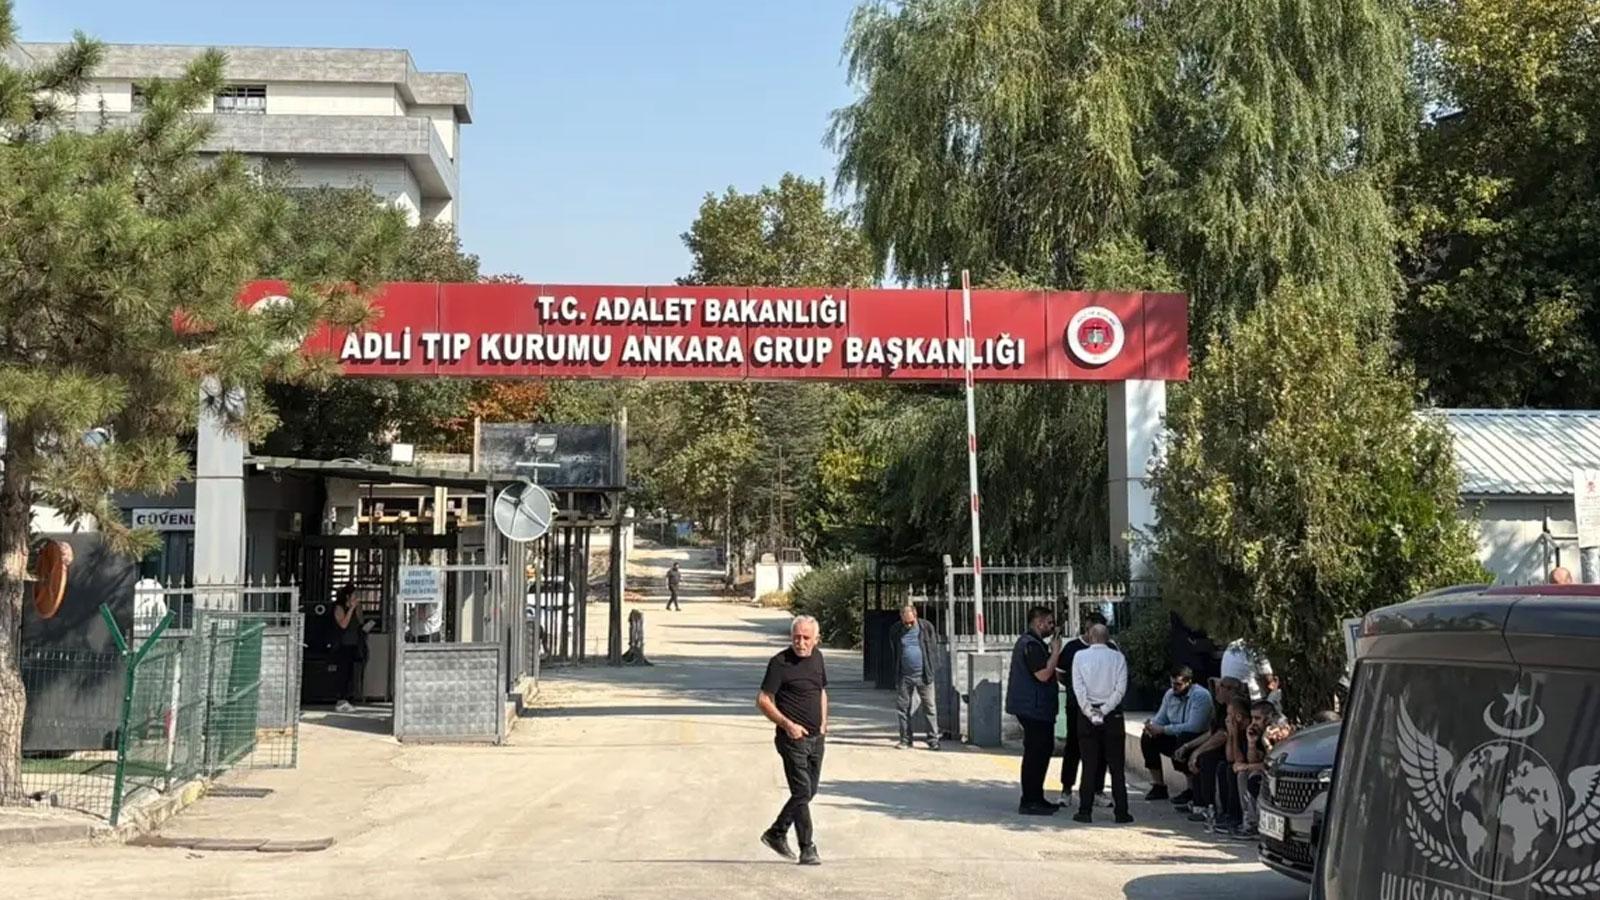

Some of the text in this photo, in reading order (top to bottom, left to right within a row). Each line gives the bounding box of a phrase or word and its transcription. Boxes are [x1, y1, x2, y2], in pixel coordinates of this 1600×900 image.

[538, 294, 847, 323] T.C. ADALET BAKANLIĞI
[341, 326, 1025, 370] ADLİ TIP KURUMU ANKARA GRUP BAŞKANLIĞI
